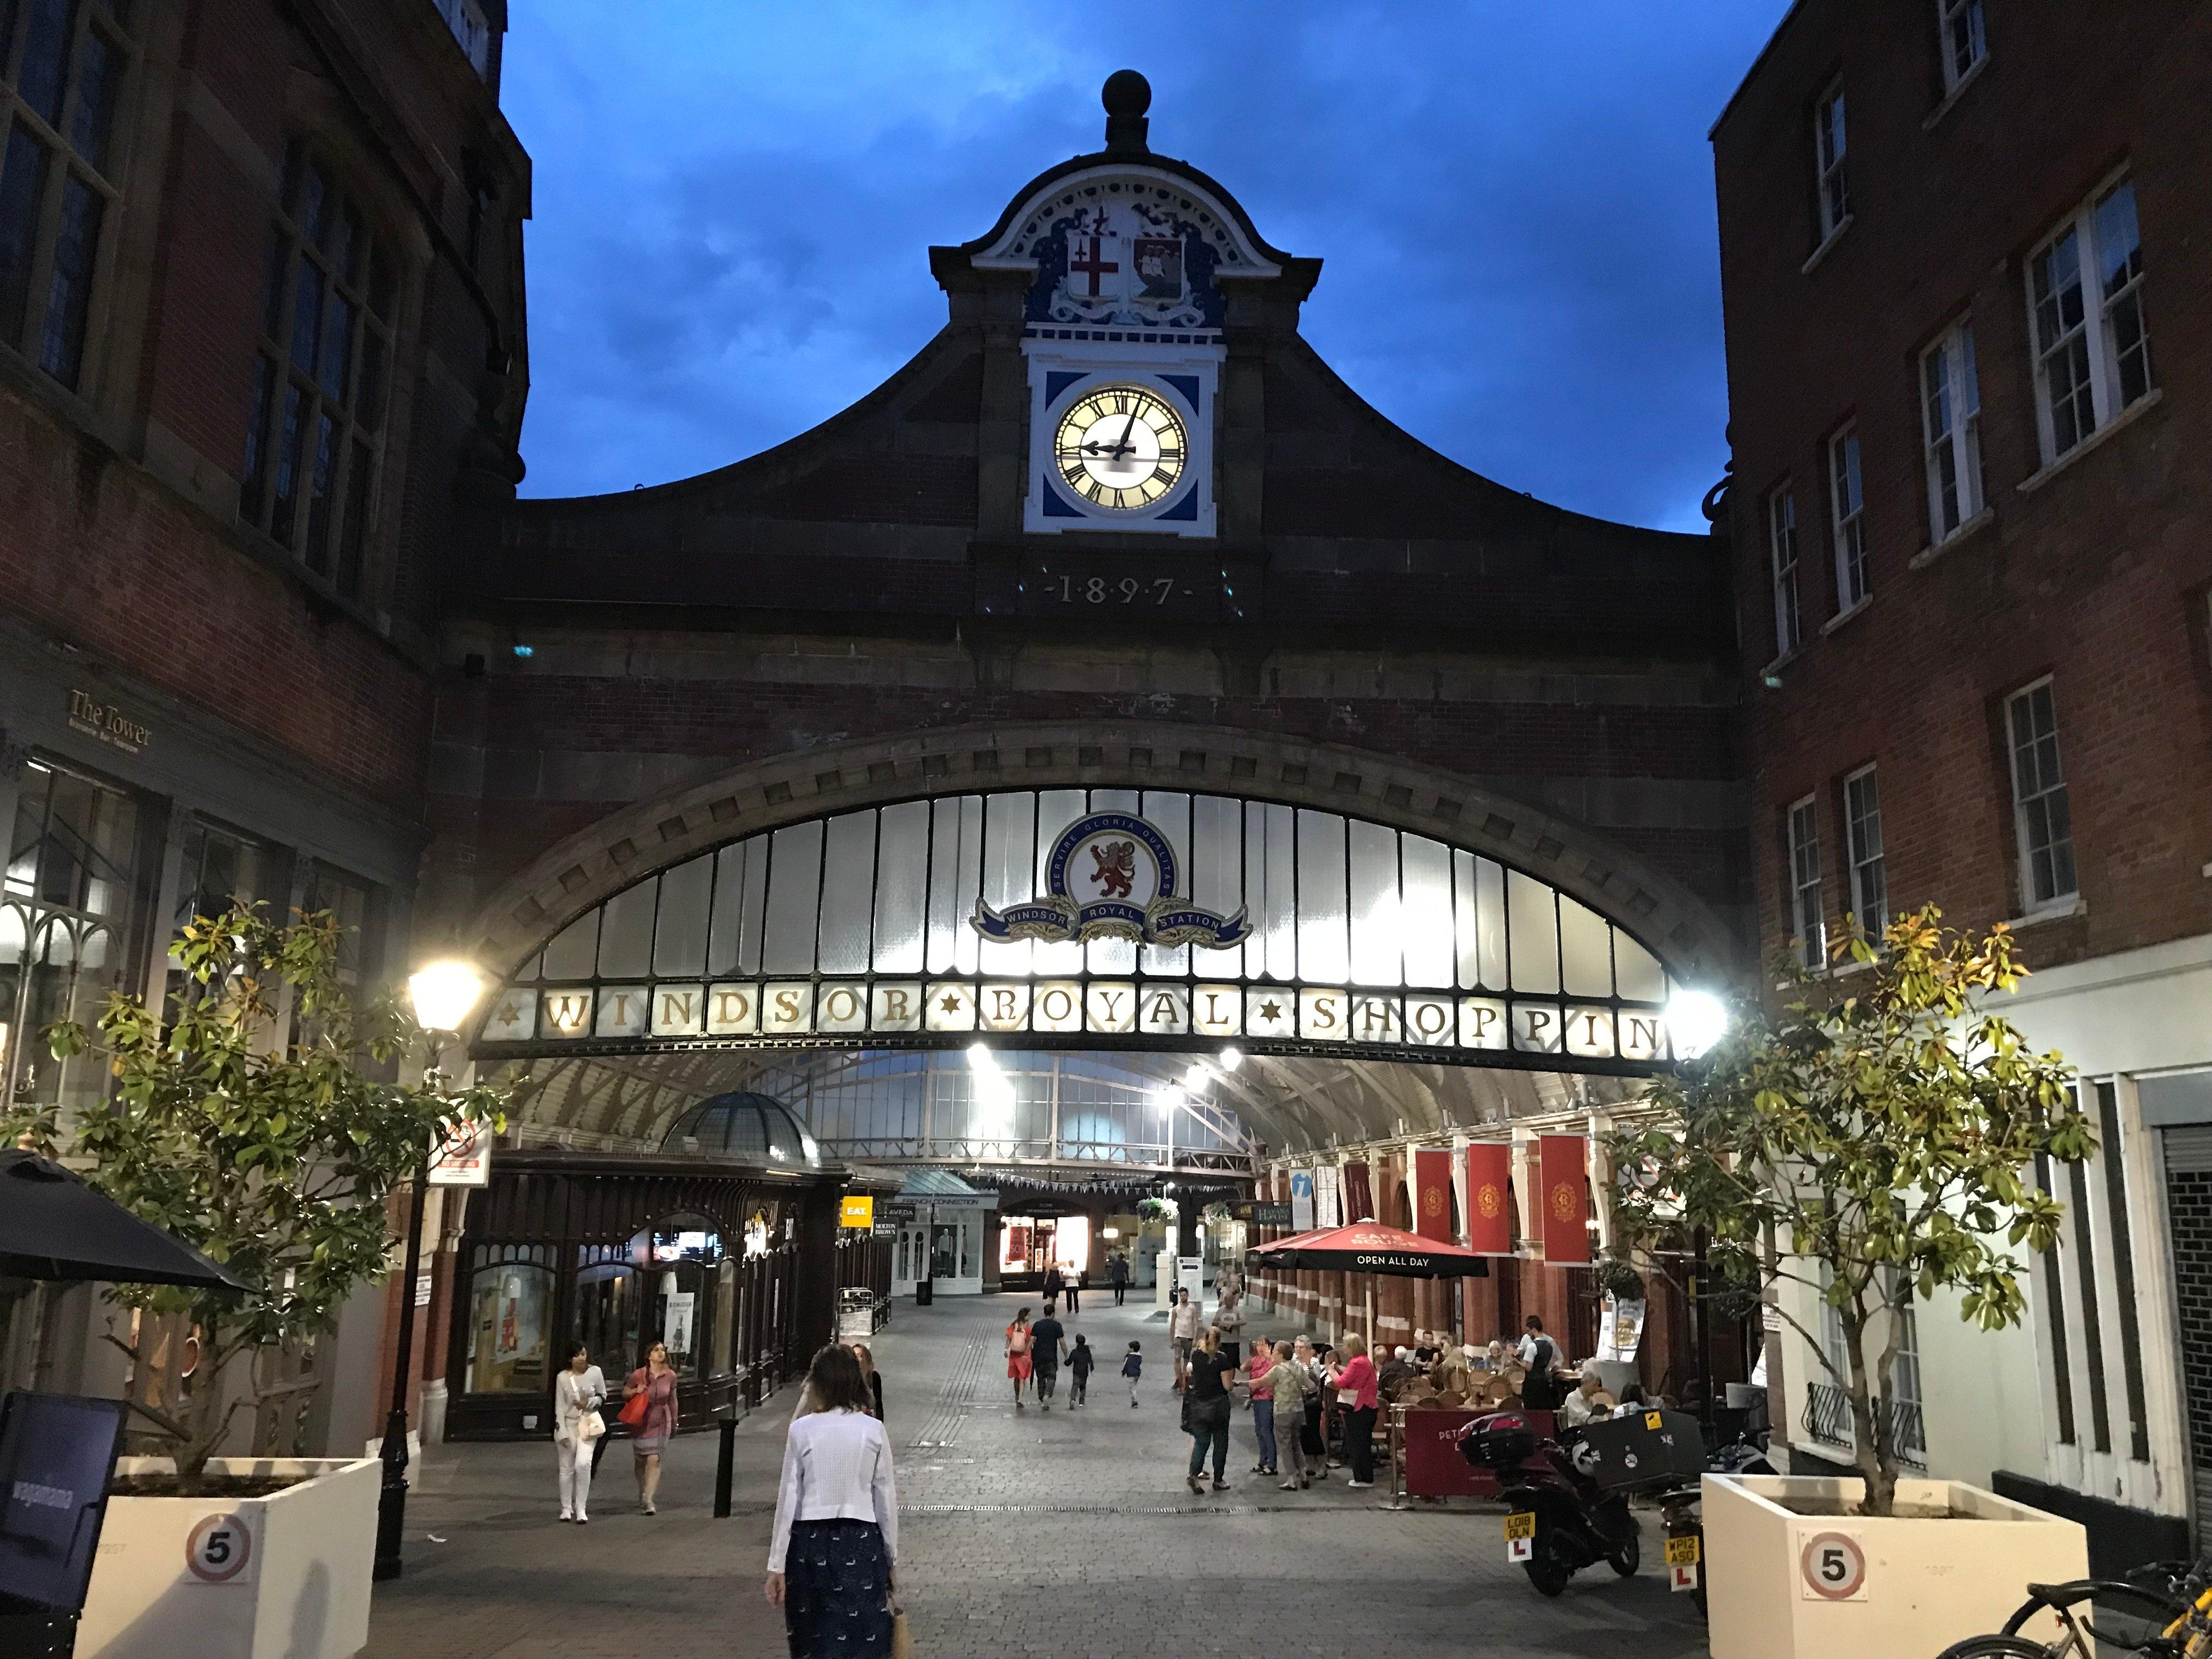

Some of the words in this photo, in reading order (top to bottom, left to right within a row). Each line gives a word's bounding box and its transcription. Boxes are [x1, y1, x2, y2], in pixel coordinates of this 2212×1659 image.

[72, 689, 103, 725] The
[106, 706, 153, 746] Tower
[1053, 834, 1077, 888] SERVIRE
[1085, 819, 1134, 831] GLORIA
[1007, 911, 1065, 924] WINDSOR
[1090, 906, 1134, 919] ROYAL
[1160, 915, 1218, 929] STATION
[546, 989, 909, 1028] WINDSOR
[991, 990, 1229, 1025] ROYAL
[1313, 998, 1657, 1049] SHOPPIN
[1357, 1256, 1385, 1265] OPEN
[1388, 1257, 1407, 1266] ALL
[1410, 1257, 1429, 1267] DAY
[206, 1532, 230, 1564] 5
[1514, 1541, 1526, 1555] L
[1669, 1538, 1695, 1551] WP12
[1677, 1567, 1691, 1585] L
[1821, 1549, 1847, 1582] 5
